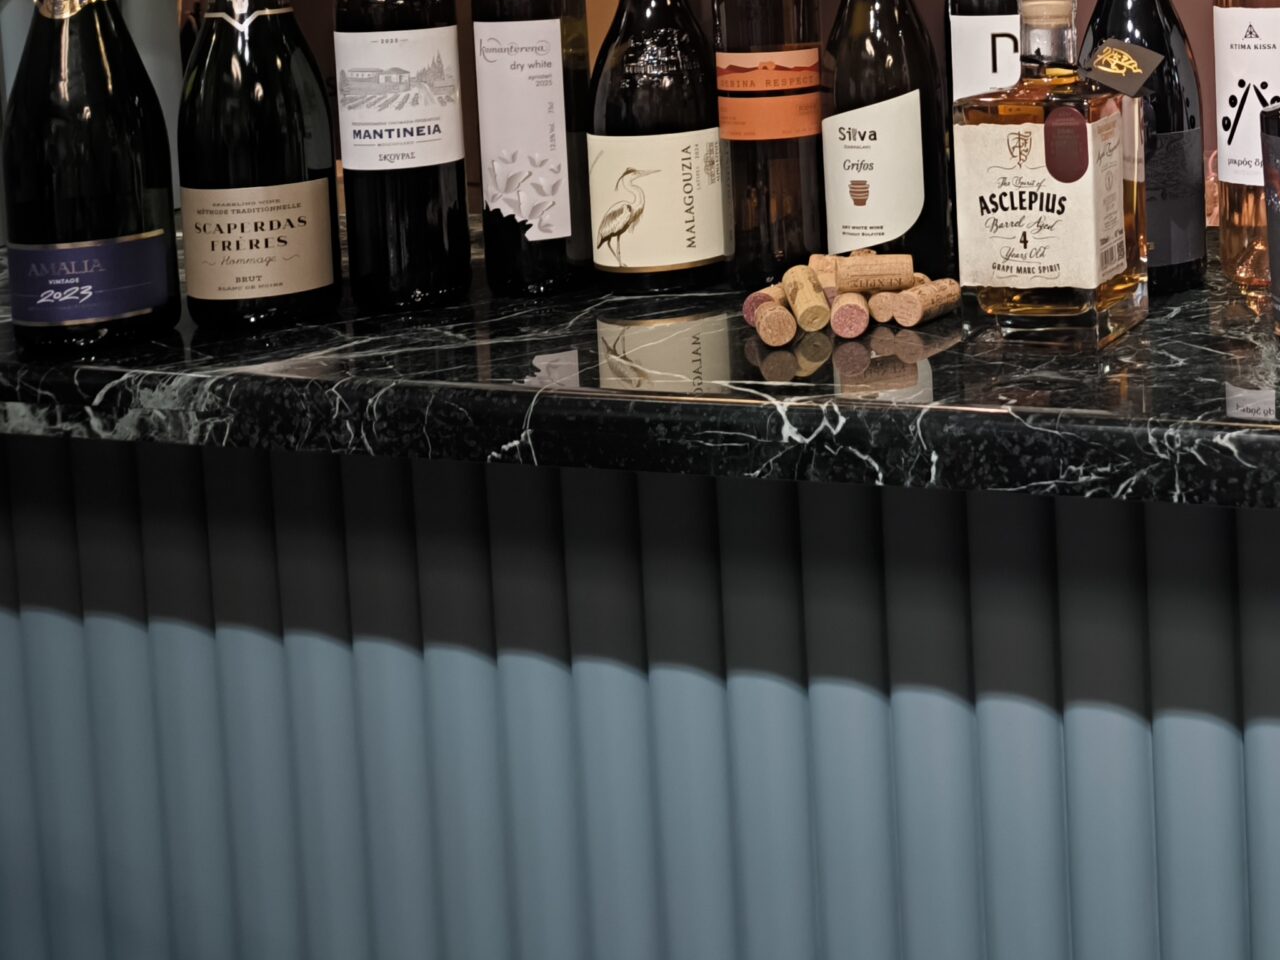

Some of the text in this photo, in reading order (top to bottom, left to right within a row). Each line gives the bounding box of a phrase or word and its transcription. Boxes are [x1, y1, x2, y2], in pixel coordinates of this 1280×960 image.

[510, 60, 552, 72] dry white
[352, 124, 442, 140] MANTINEIA
[378, 152, 416, 163] ΣΚΟΥΡΑΣ
[843, 159, 874, 173] Grifos
[681, 144, 697, 248] MALAGOUZIA
[978, 190, 1067, 216] ASCLEPIUS
[231, 203, 302, 215] TRADITIONNELLE
[194, 215, 308, 235] SCAPERDAS
[984, 215, 1062, 235] Barrel Aged
[211, 235, 288, 252] FRÈRES
[1019, 231, 1029, 250] 4
[220, 255, 277, 267] Hommage
[1000, 246, 1028, 262] Years
[28, 258, 106, 277] AMALIA
[992, 262, 1061, 275] GRAPE MARC SPIRIT
[48, 277, 80, 285] VINTAGE
[235, 275, 262, 283] BRUT
[36, 285, 93, 304] 2023
